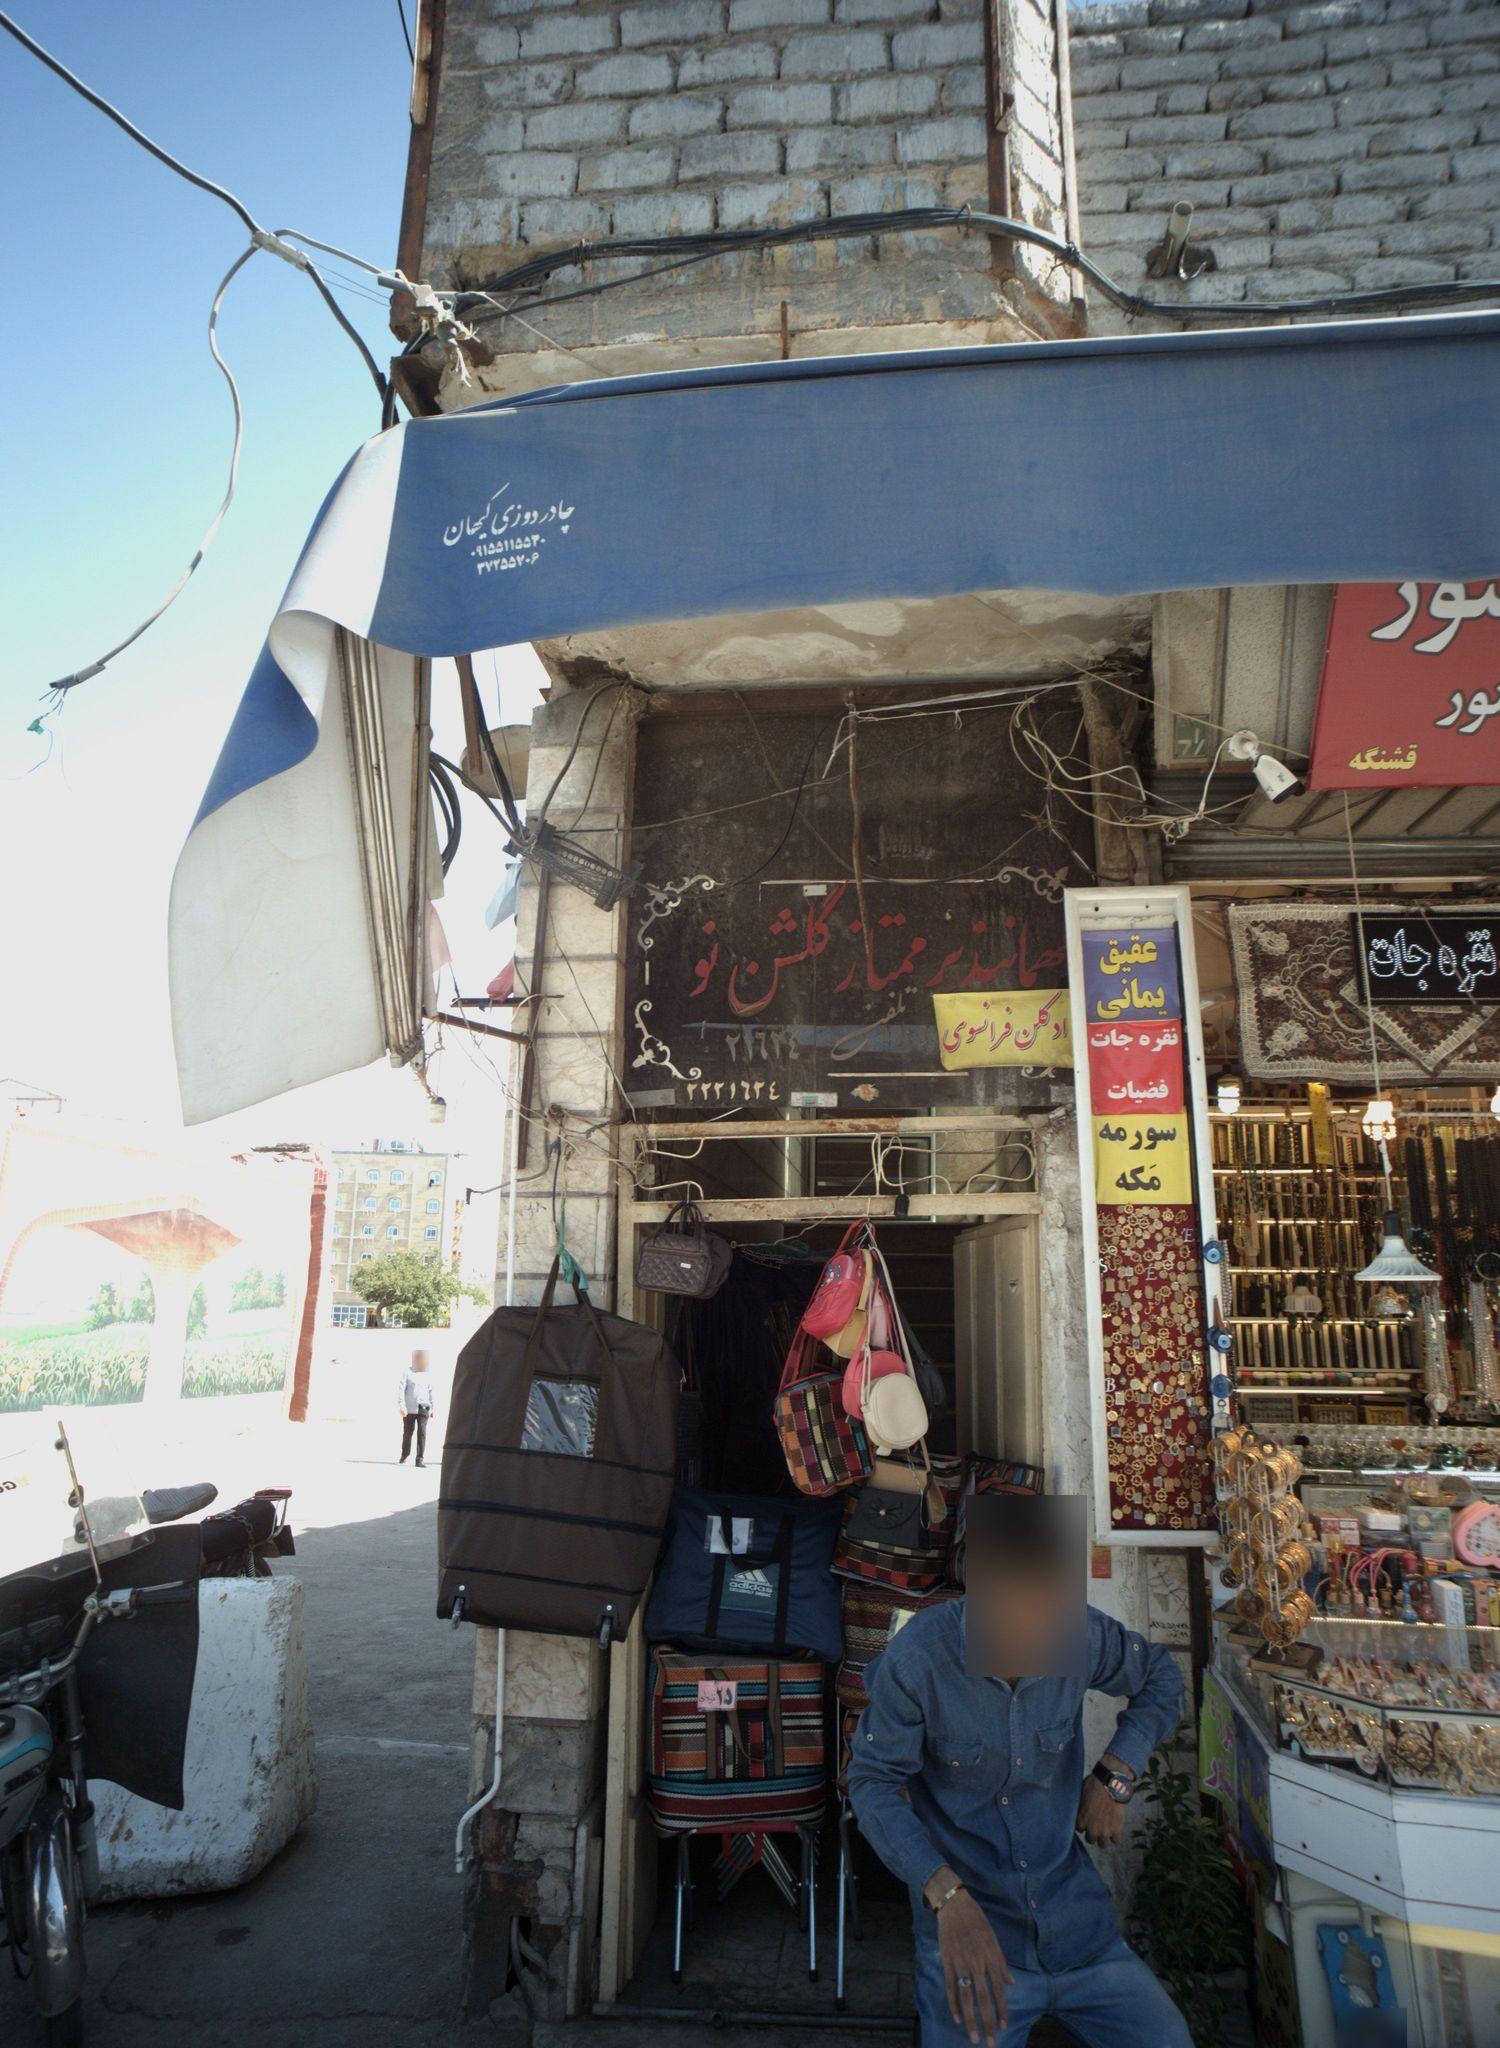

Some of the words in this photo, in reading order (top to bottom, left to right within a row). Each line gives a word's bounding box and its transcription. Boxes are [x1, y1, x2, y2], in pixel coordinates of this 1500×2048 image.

[443, 482, 510, 546] کیهان
[689, 920, 719, 998] نو
[728, 880, 849, 1015] گلشن
[834, 911, 927, 993] ممتاز
[1100, 935, 1157, 974] عقیق
[1368, 928, 1432, 991] جات
[1437, 928, 1498, 993] نقره
[1097, 978, 1167, 1019] یمانی
[942, 1000, 1013, 1053] فرانسوی
[1090, 1028, 1134, 1051] جات
[1138, 1027, 1179, 1052] نقره
[1107, 1079, 1169, 1104] فضیات
[729, 1580, 773, 1594] adidas
